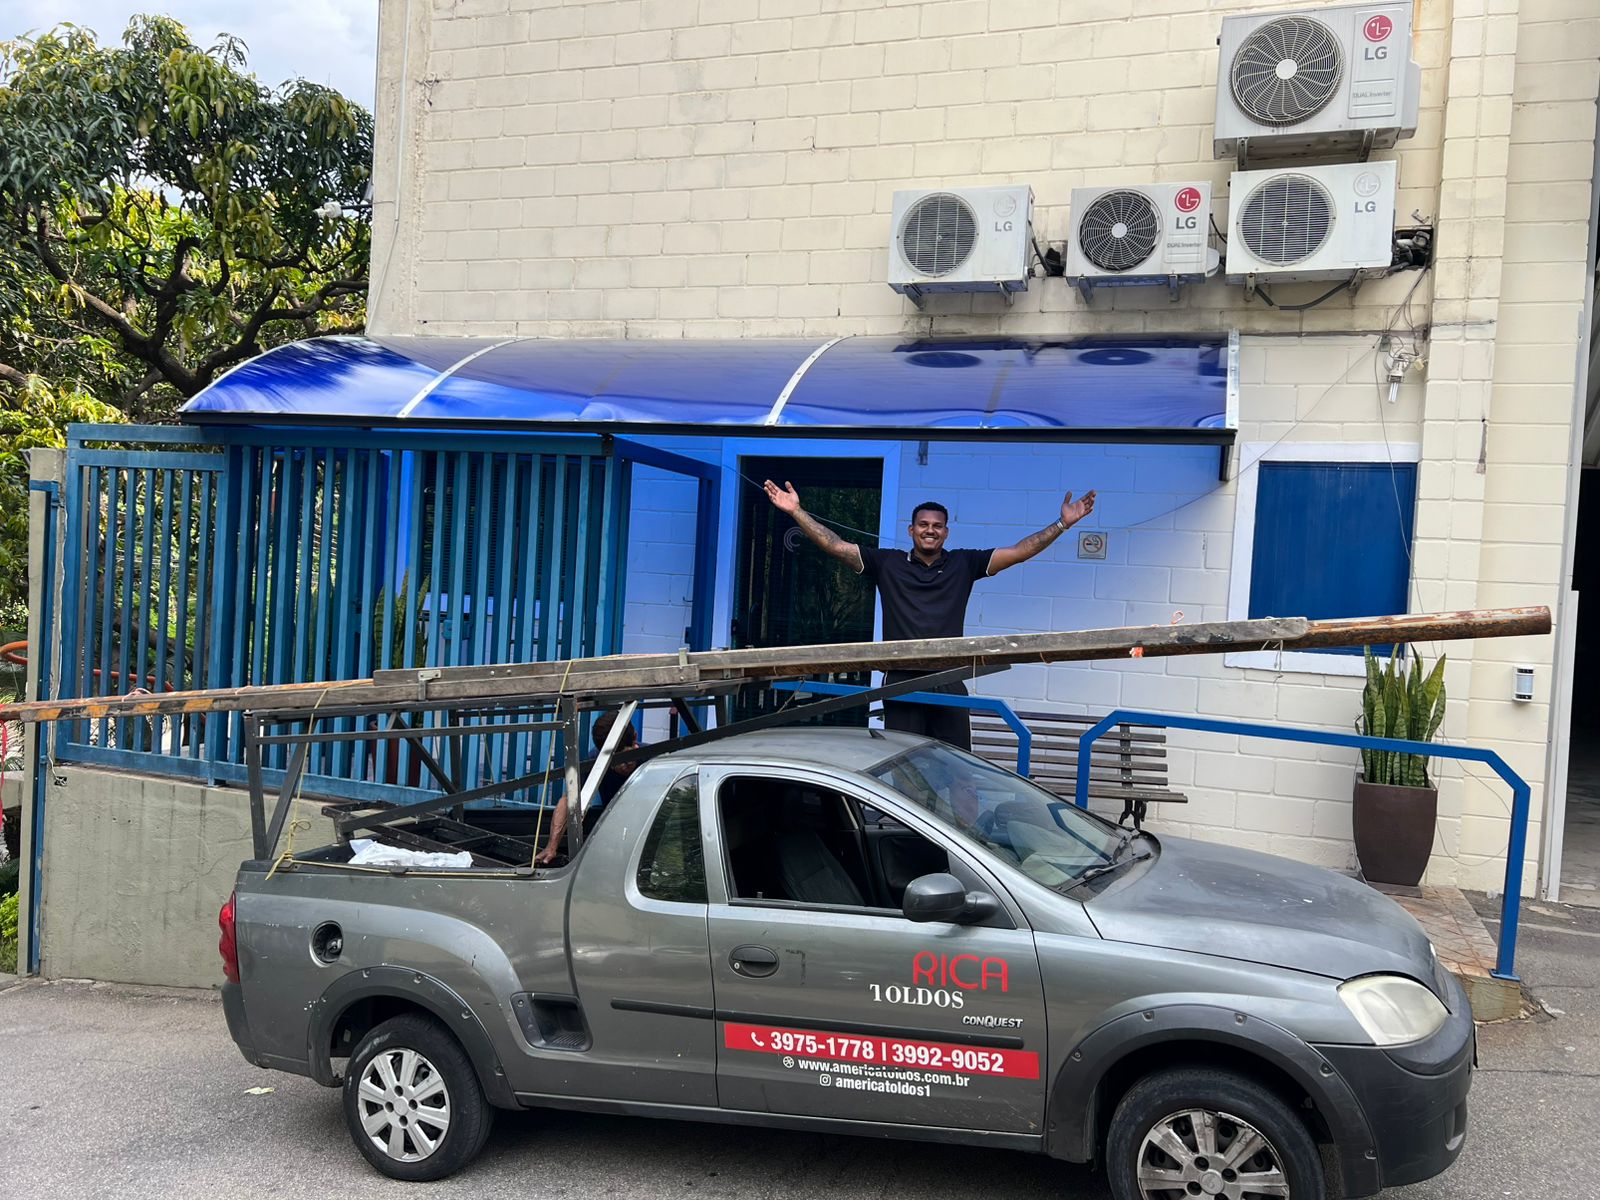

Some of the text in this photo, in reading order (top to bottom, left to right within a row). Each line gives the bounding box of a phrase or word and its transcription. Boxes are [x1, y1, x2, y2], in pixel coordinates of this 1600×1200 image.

[1364, 46, 1388, 61] LG
[1354, 201, 1376, 213] LG
[994, 220, 1013, 232] LG
[1176, 216, 1197, 230] LG
[912, 948, 1009, 993] RICA
[770, 1031, 875, 1060] 3975-1778
[891, 1043, 1004, 1073] 3992-9052
[835, 1077, 931, 1097] americatoldos1
